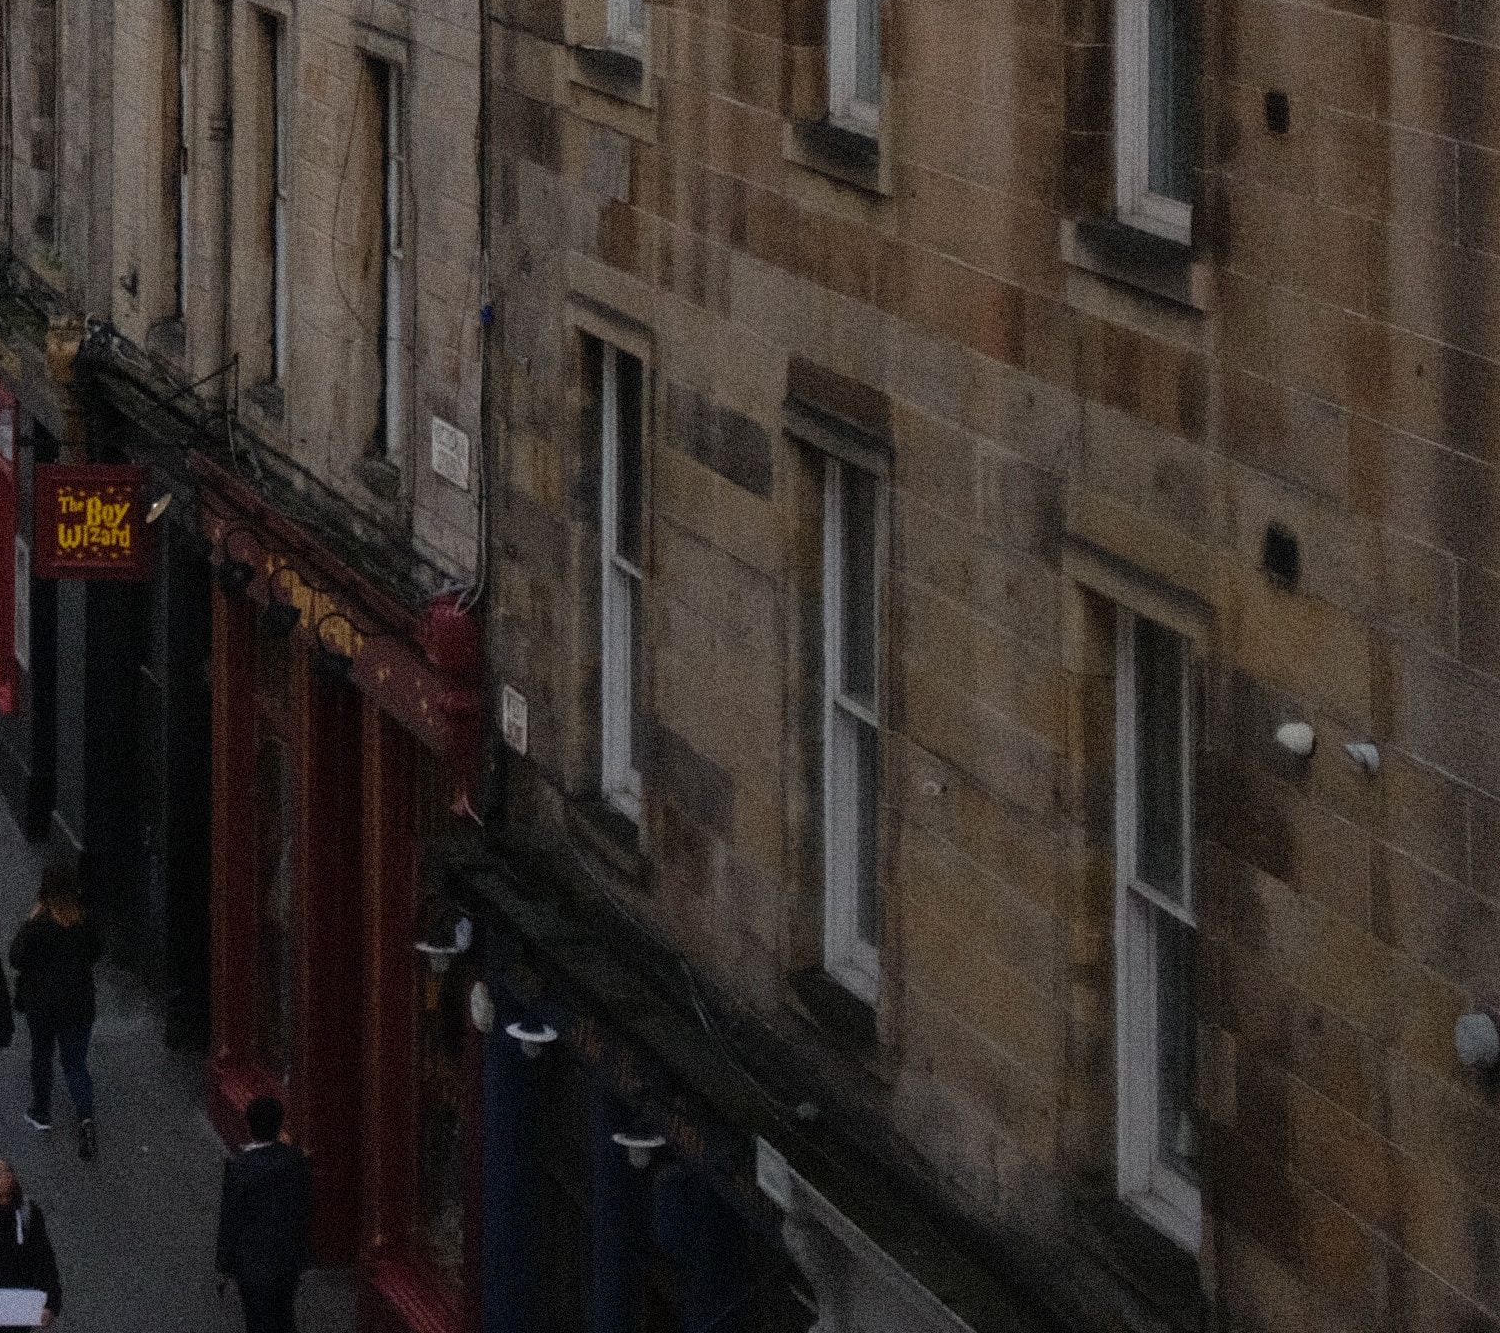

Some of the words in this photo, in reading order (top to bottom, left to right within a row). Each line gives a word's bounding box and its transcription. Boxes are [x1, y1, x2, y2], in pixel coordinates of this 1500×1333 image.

[58, 496, 84, 514] The
[86, 496, 131, 528] Boy
[58, 523, 131, 549] Wizard
